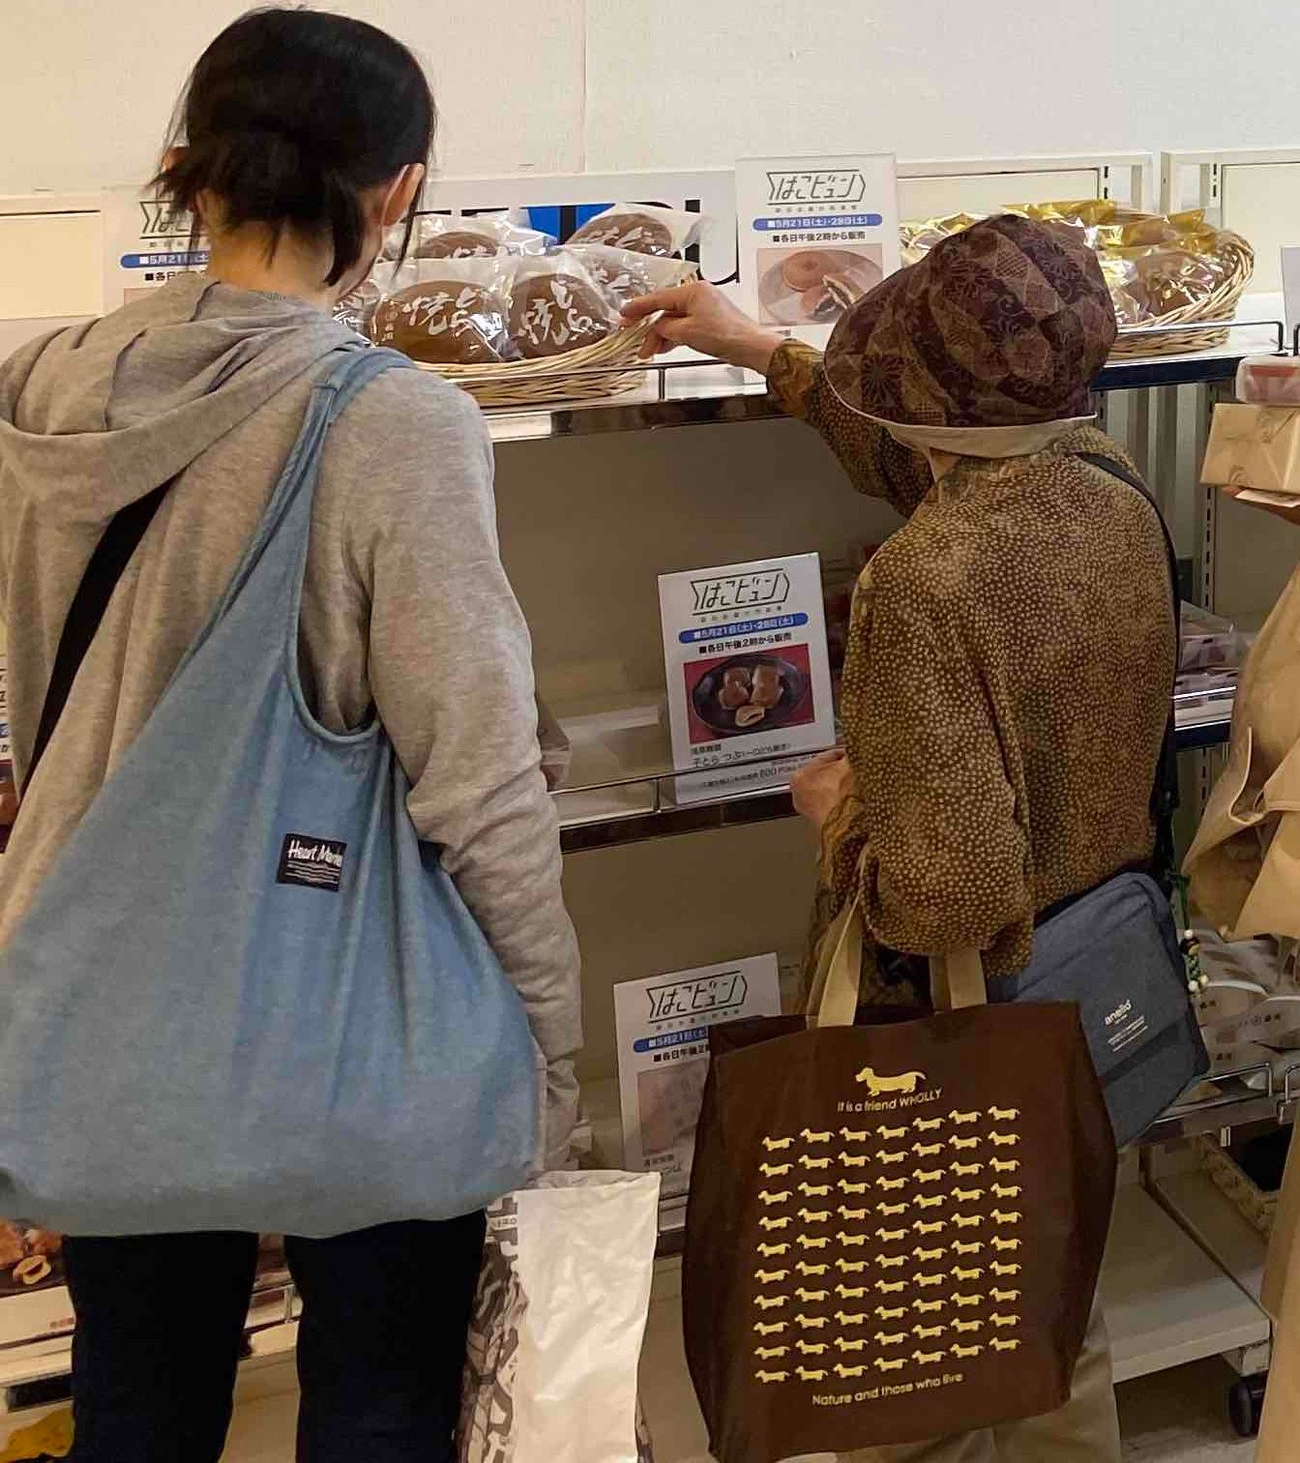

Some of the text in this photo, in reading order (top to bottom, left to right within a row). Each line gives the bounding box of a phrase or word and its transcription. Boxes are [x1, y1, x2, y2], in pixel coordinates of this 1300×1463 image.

[775, 174, 857, 200] はこビュン
[700, 574, 780, 610] はこビュン
[864, 1099, 897, 1112] friend
[899, 1088, 942, 1108] WHOLLY
[812, 1394, 852, 1406] Nature
[854, 1386, 879, 1401] and
[881, 1382, 914, 1396] those
[915, 1376, 941, 1389] who
